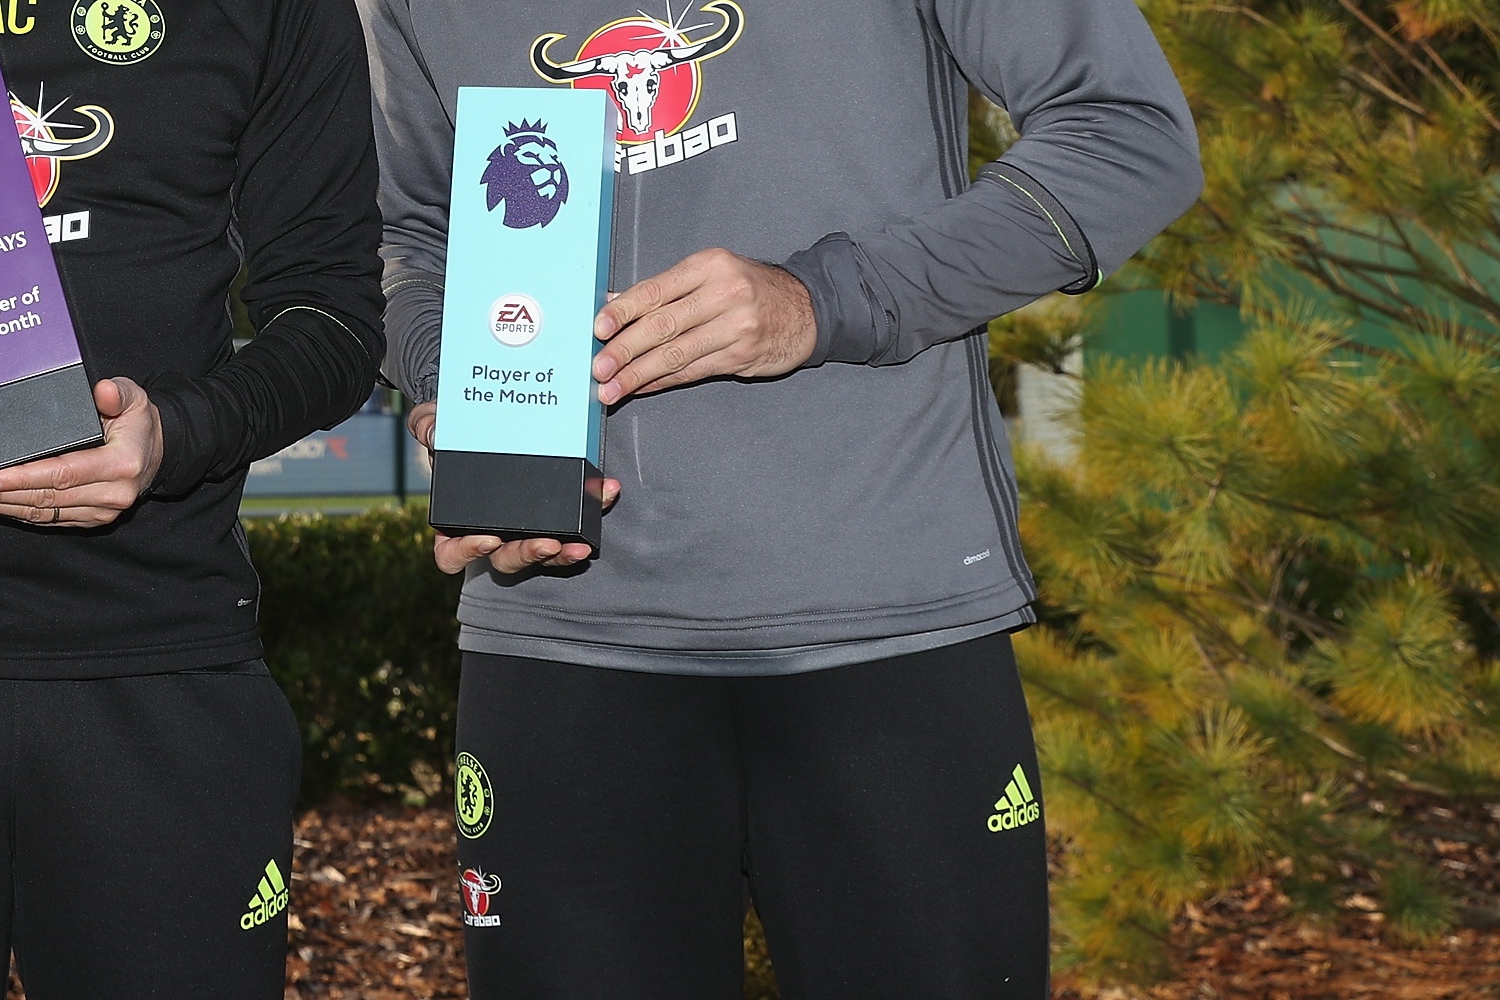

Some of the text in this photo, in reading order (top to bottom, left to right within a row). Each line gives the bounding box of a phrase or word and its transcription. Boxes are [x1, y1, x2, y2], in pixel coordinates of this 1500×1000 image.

[87, 44, 150, 61] FOOTBALL CLUB
[21, 285, 41, 305] of
[496, 303, 534, 323] EA
[495, 323, 535, 333] SPORTS
[472, 365, 554, 384] Player of
[463, 386, 558, 406] the Month
[987, 801, 1040, 833] adidas
[240, 888, 289, 930] adidas
